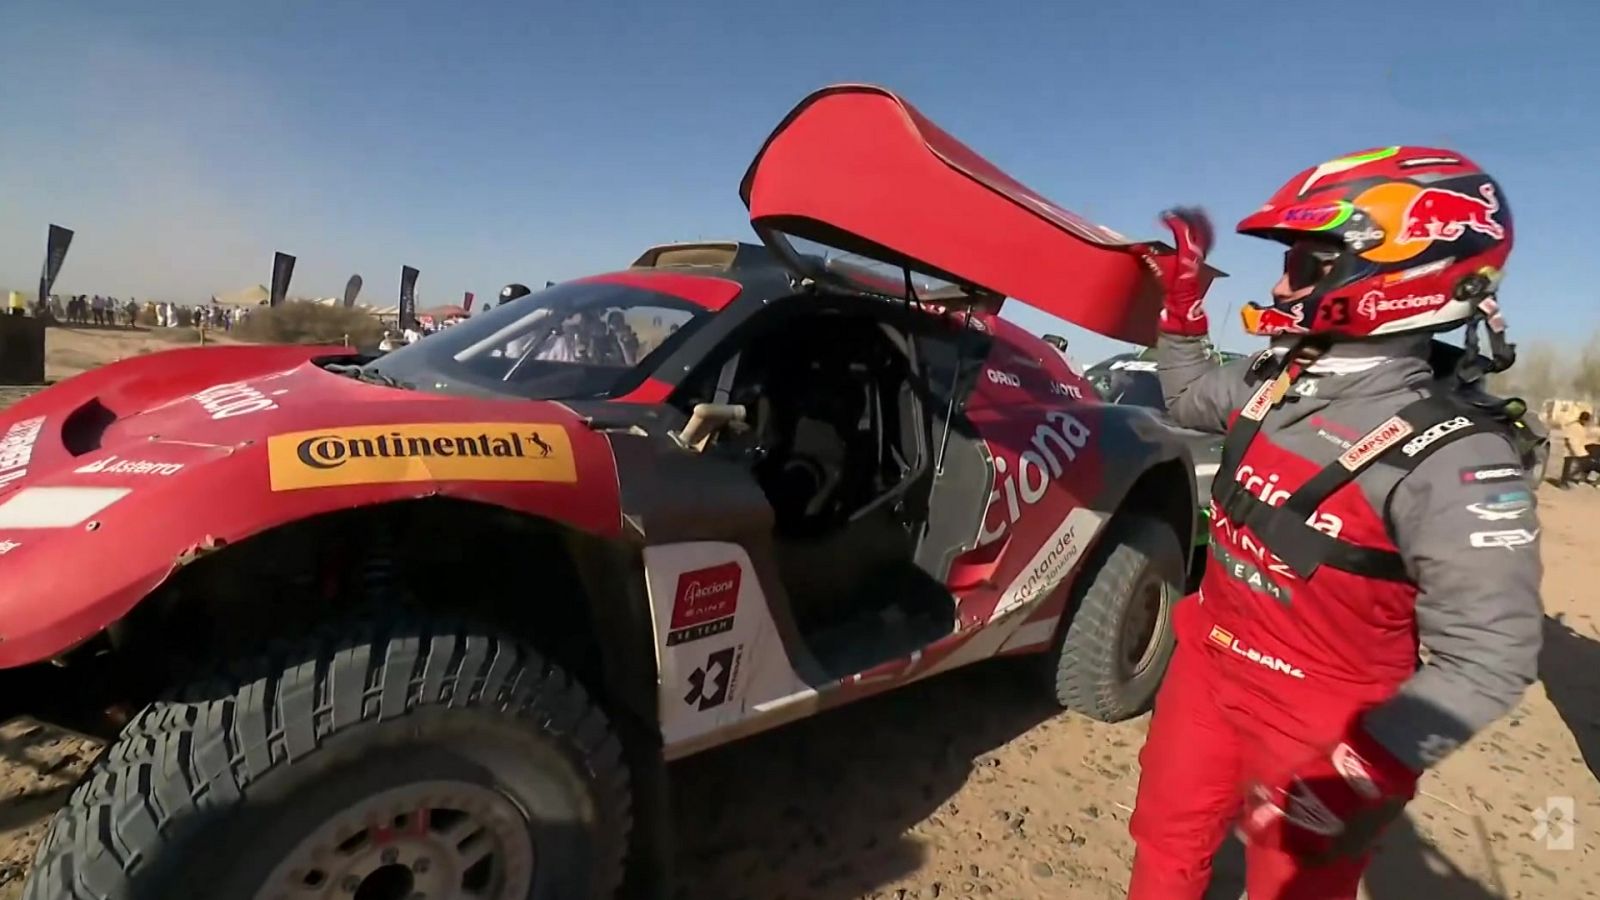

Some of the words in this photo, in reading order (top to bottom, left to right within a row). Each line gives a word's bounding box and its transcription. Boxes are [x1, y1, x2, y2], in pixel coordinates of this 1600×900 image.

[1376, 294, 1445, 312] acciona
[987, 369, 1020, 388] GRID
[297, 431, 524, 469] Continental
[1348, 424, 1400, 463] SIMPSON
[1401, 416, 1475, 457] sparco
[975, 410, 1091, 547] ciona
[1013, 524, 1077, 606] Santander
[694, 580, 733, 598] acciona
